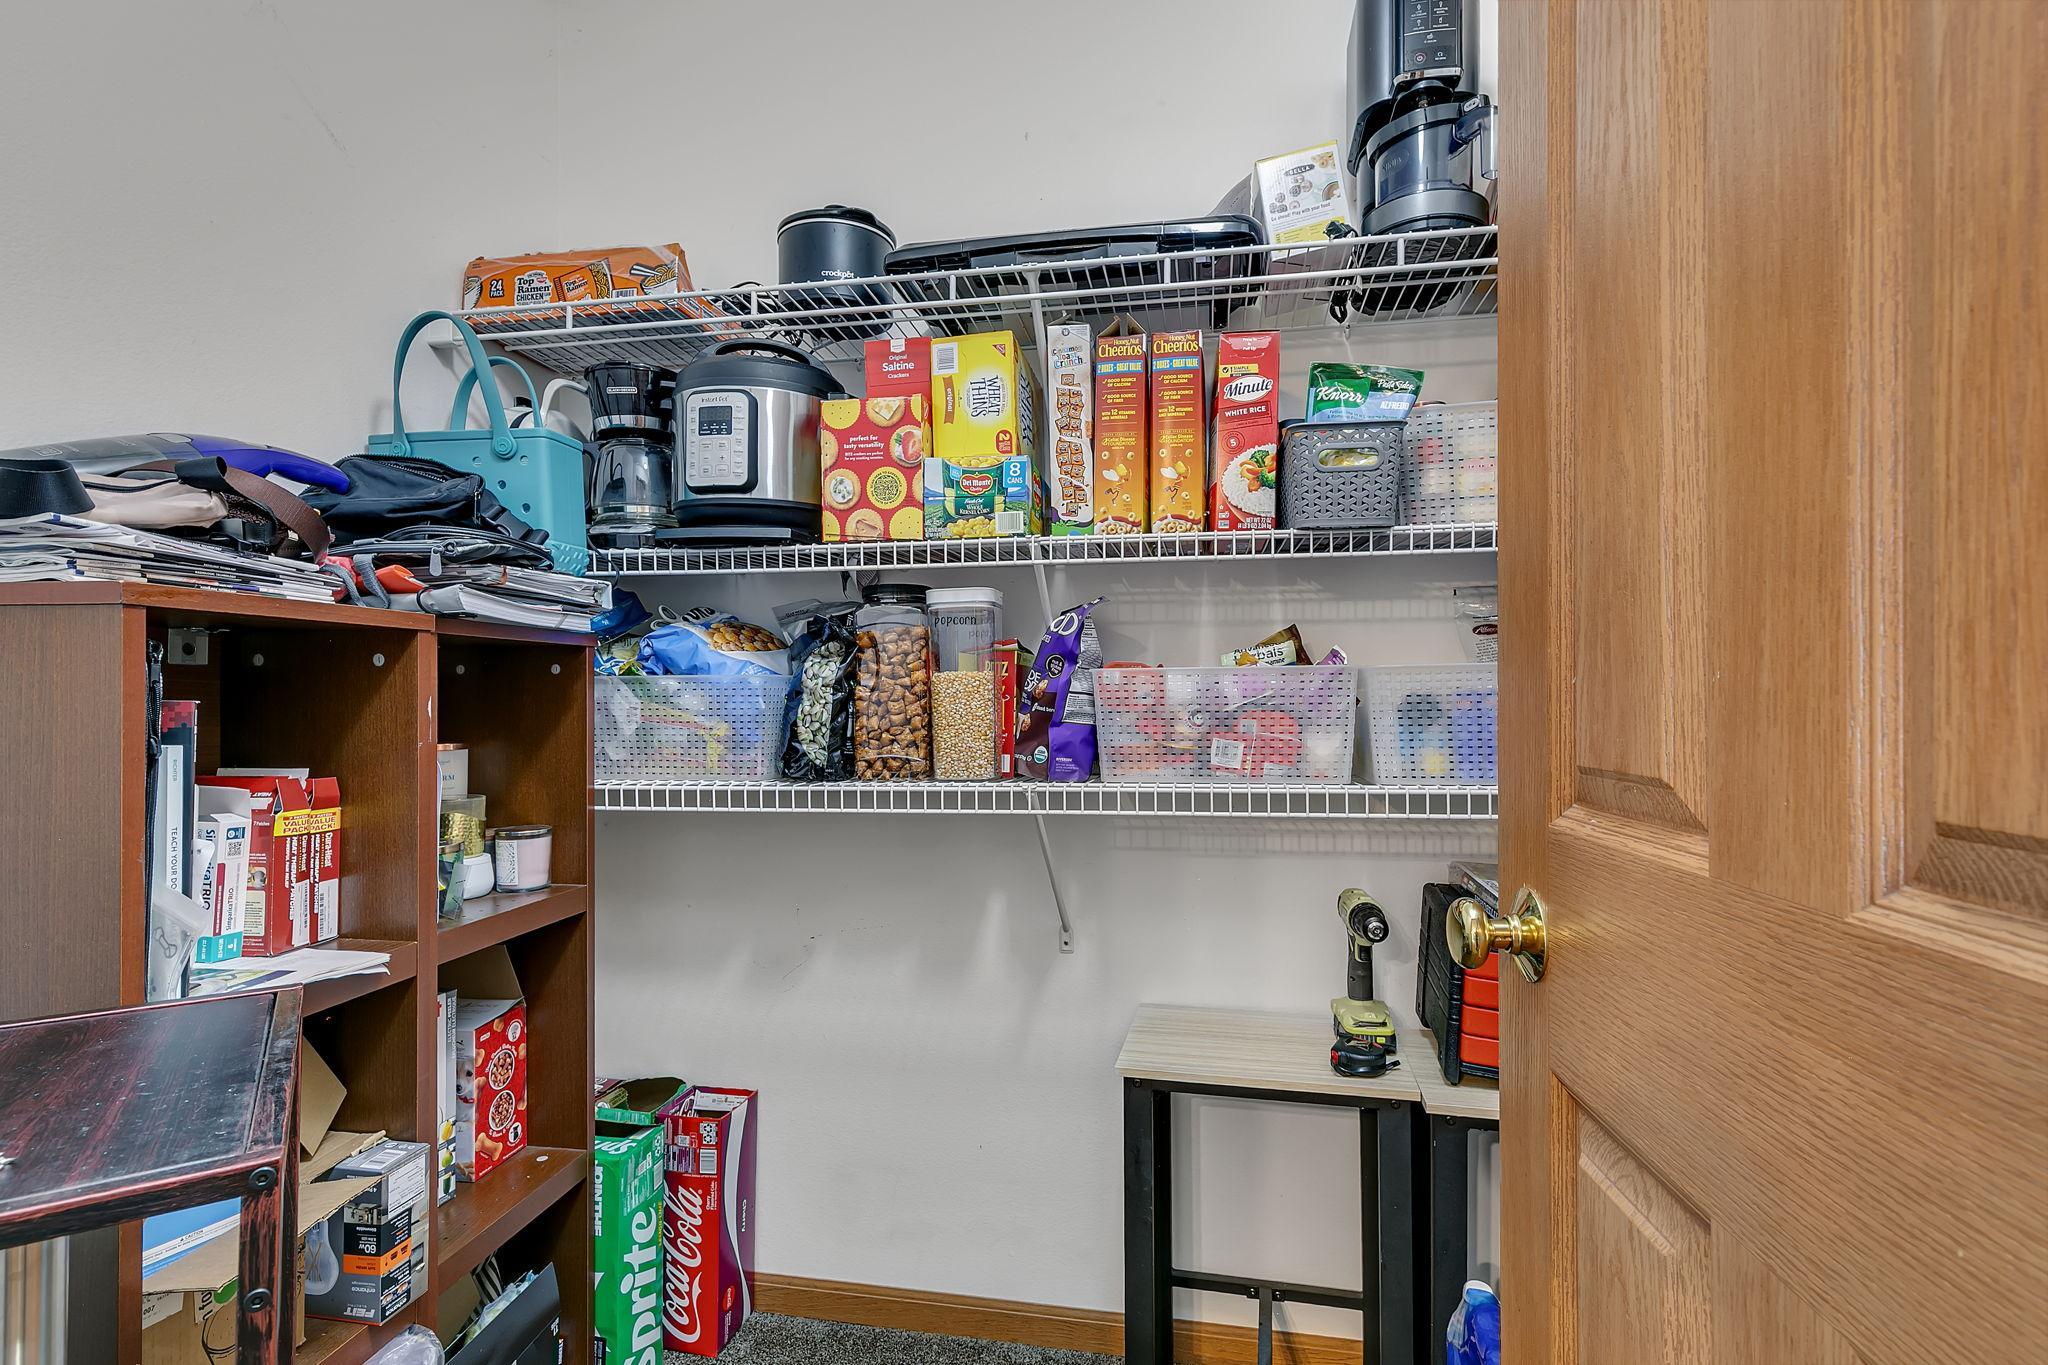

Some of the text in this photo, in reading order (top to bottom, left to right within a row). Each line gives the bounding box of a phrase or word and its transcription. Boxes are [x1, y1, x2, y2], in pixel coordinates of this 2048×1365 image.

[821, 269, 854, 280] crockpot
[491, 280, 503, 291] 24
[517, 277, 535, 287] Top
[564, 280, 577, 288] Top
[565, 280, 588, 293] Ramen
[517, 284, 551, 294] Ramen
[516, 293, 544, 302] CHICKEN
[1098, 344, 1142, 357] Cheerios
[1153, 340, 1199, 354] Cheerios
[882, 361, 915, 371] Saltine
[1054, 355, 1083, 369] Crunch
[1225, 378, 1274, 398] Minute
[1377, 379, 1395, 389] Pasta
[946, 387, 954, 412] original
[987, 375, 1001, 416] WHEAT
[1316, 386, 1365, 403] Knorr
[1224, 405, 1267, 417] WHITE RICE
[1380, 401, 1410, 410] ALFREDO
[849, 435, 869, 443] perfect
[999, 432, 1010, 441] 2
[1229, 438, 1237, 447] 5
[1009, 462, 1021, 477] 8
[933, 616, 978, 628] popcorn
[309, 816, 335, 826] VALUE
[324, 832, 333, 868] Cura-Heat
[170, 853, 178, 876] YOUR
[662, 1182, 704, 1344] Coca-Cola
[343, 1306, 376, 1318] FEIT
